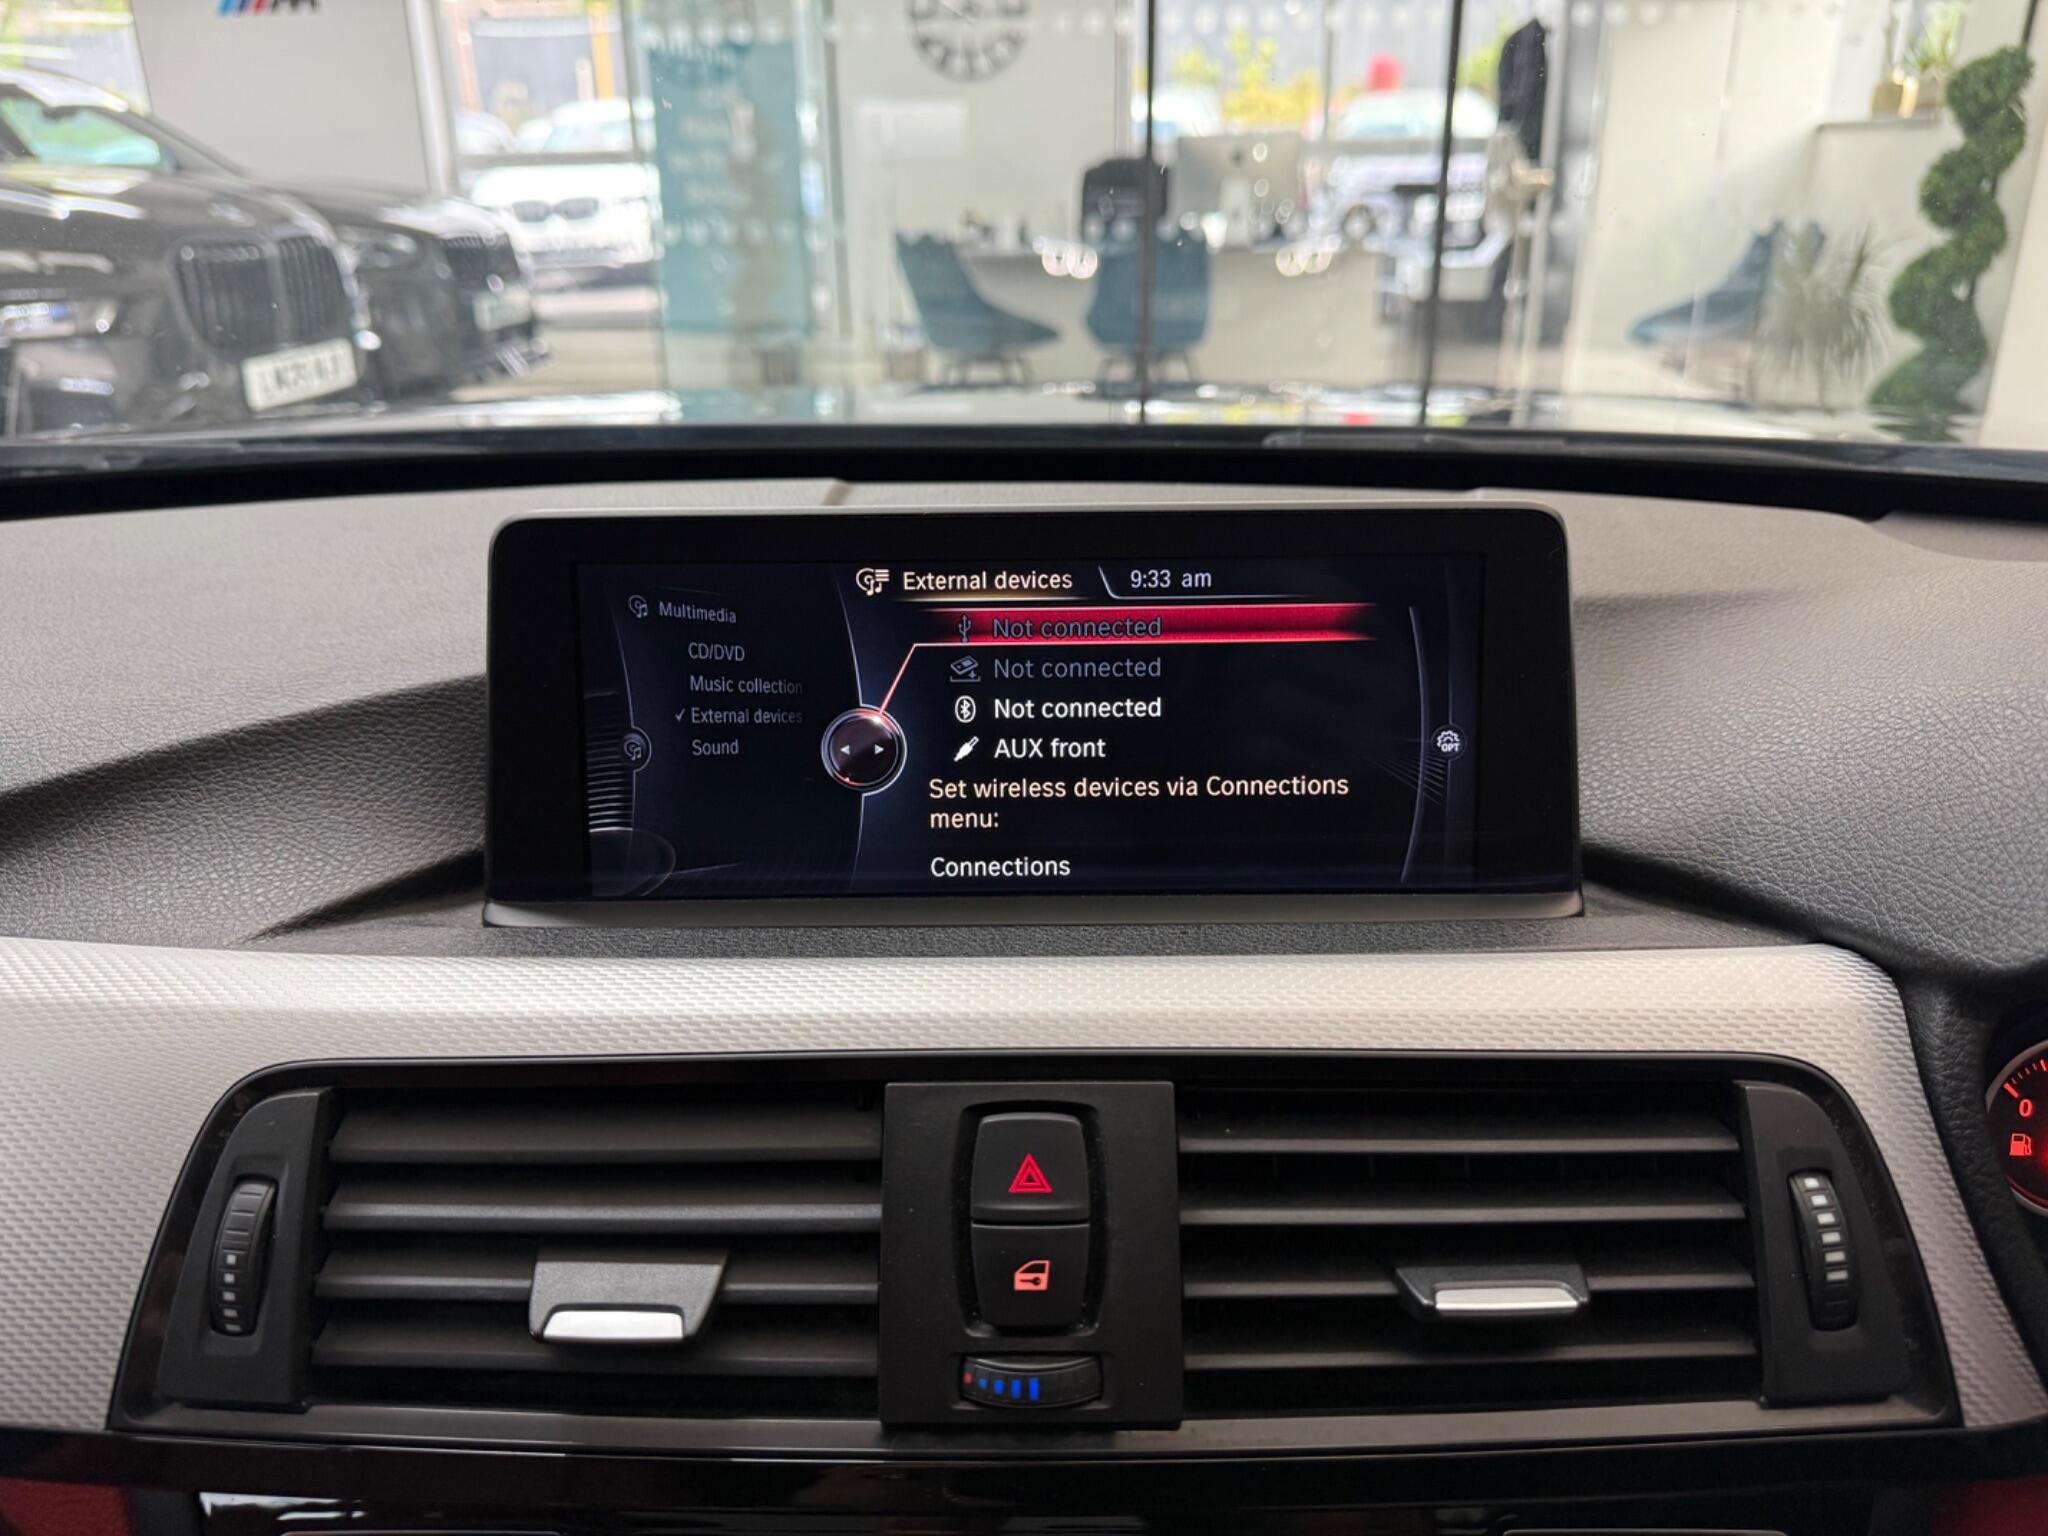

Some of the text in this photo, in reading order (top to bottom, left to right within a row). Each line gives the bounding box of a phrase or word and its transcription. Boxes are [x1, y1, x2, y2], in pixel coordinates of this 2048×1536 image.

[903, 570, 1073, 591] External devices
[1130, 569, 1212, 588] 9:33 am
[658, 601, 737, 623] Multimedia
[993, 617, 1162, 638] Not connected
[688, 642, 745, 662] CD/DVD
[994, 657, 1162, 679] Not connected
[689, 675, 803, 694] Music collection
[690, 707, 803, 724] External devices
[994, 697, 1162, 719] Not connected
[692, 738, 740, 756] Sound
[994, 738, 1106, 759] AUX front
[928, 775, 1350, 799] Set wireless devices via Connections
[929, 809, 999, 829] menu:
[930, 856, 1071, 878] Connections
